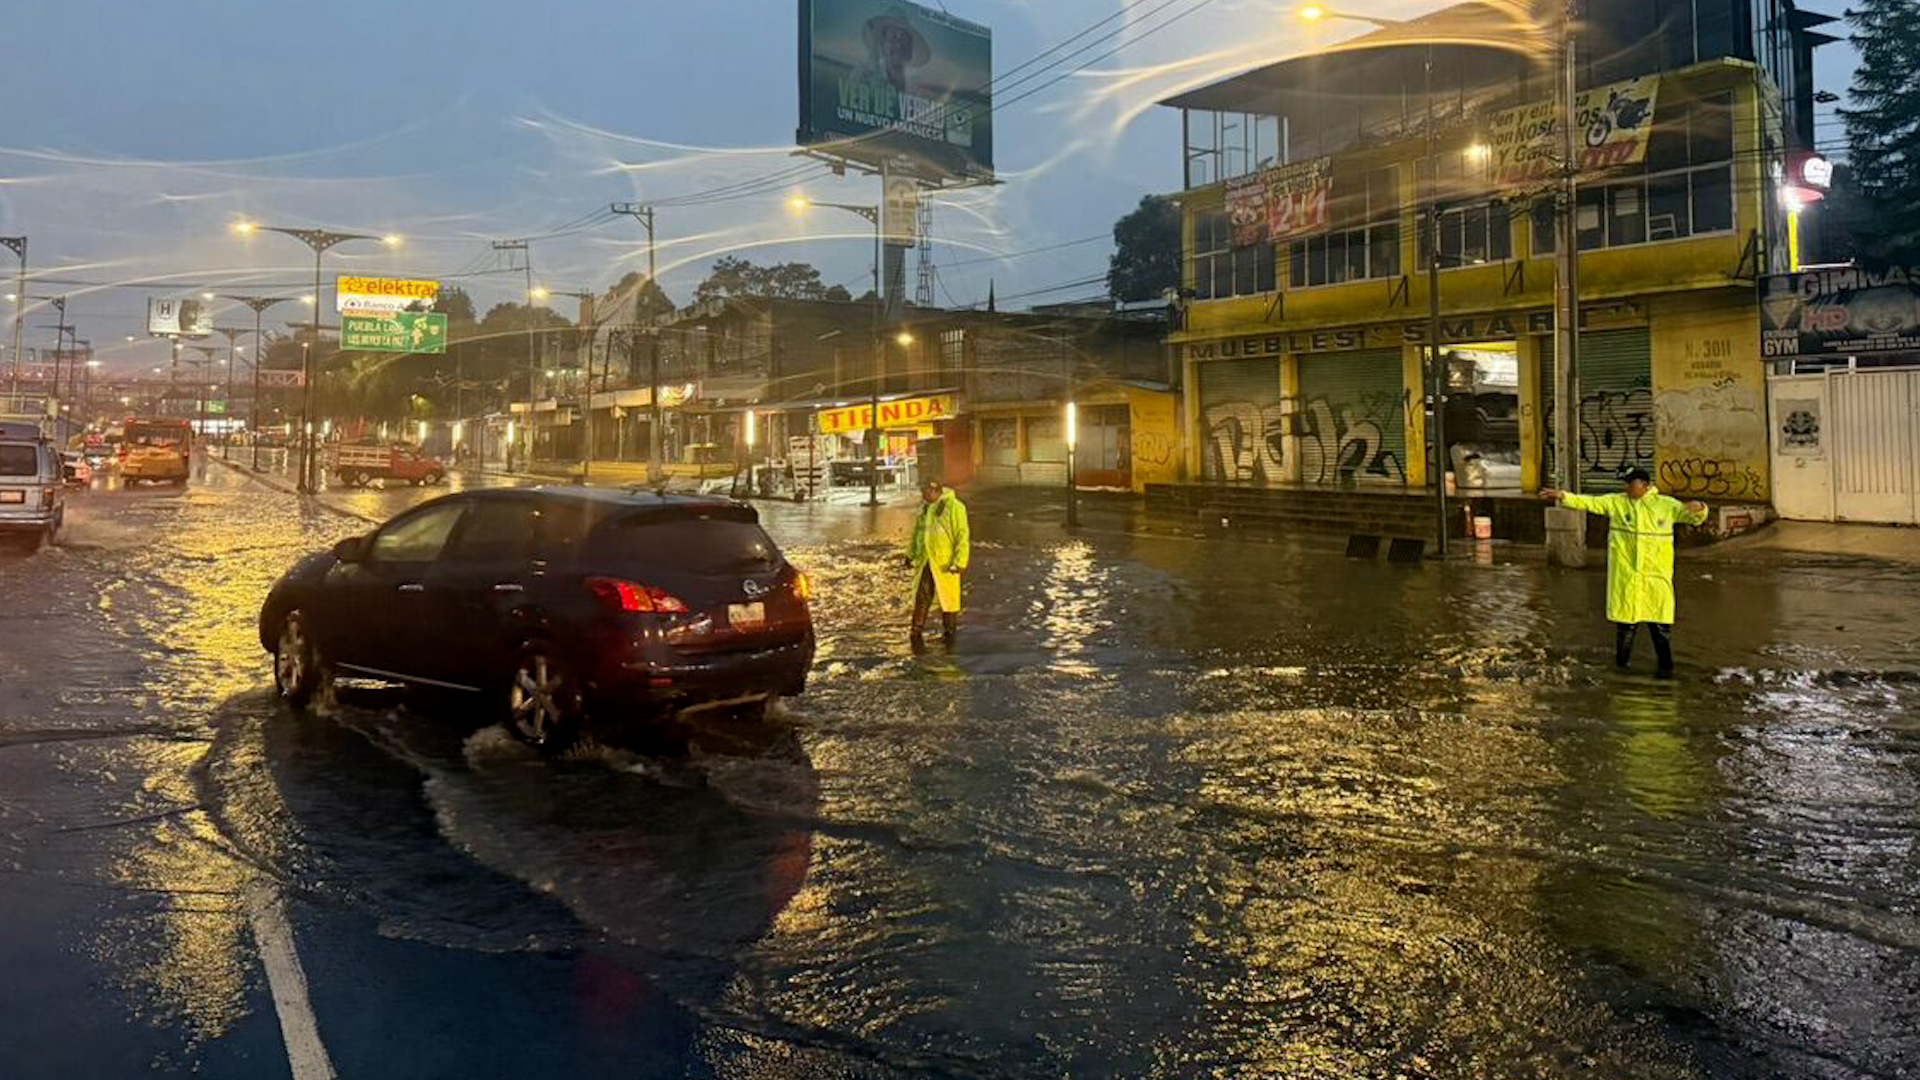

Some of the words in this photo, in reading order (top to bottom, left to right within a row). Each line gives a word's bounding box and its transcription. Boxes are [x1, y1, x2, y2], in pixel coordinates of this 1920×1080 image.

[837, 106, 853, 121] UN
[855, 112, 890, 128] NUEVO
[366, 281, 432, 296] elektra
[1191, 331, 1358, 361] MUEBLES
[1764, 338, 1799, 354] GYM
[828, 399, 943, 429] TIENDA
